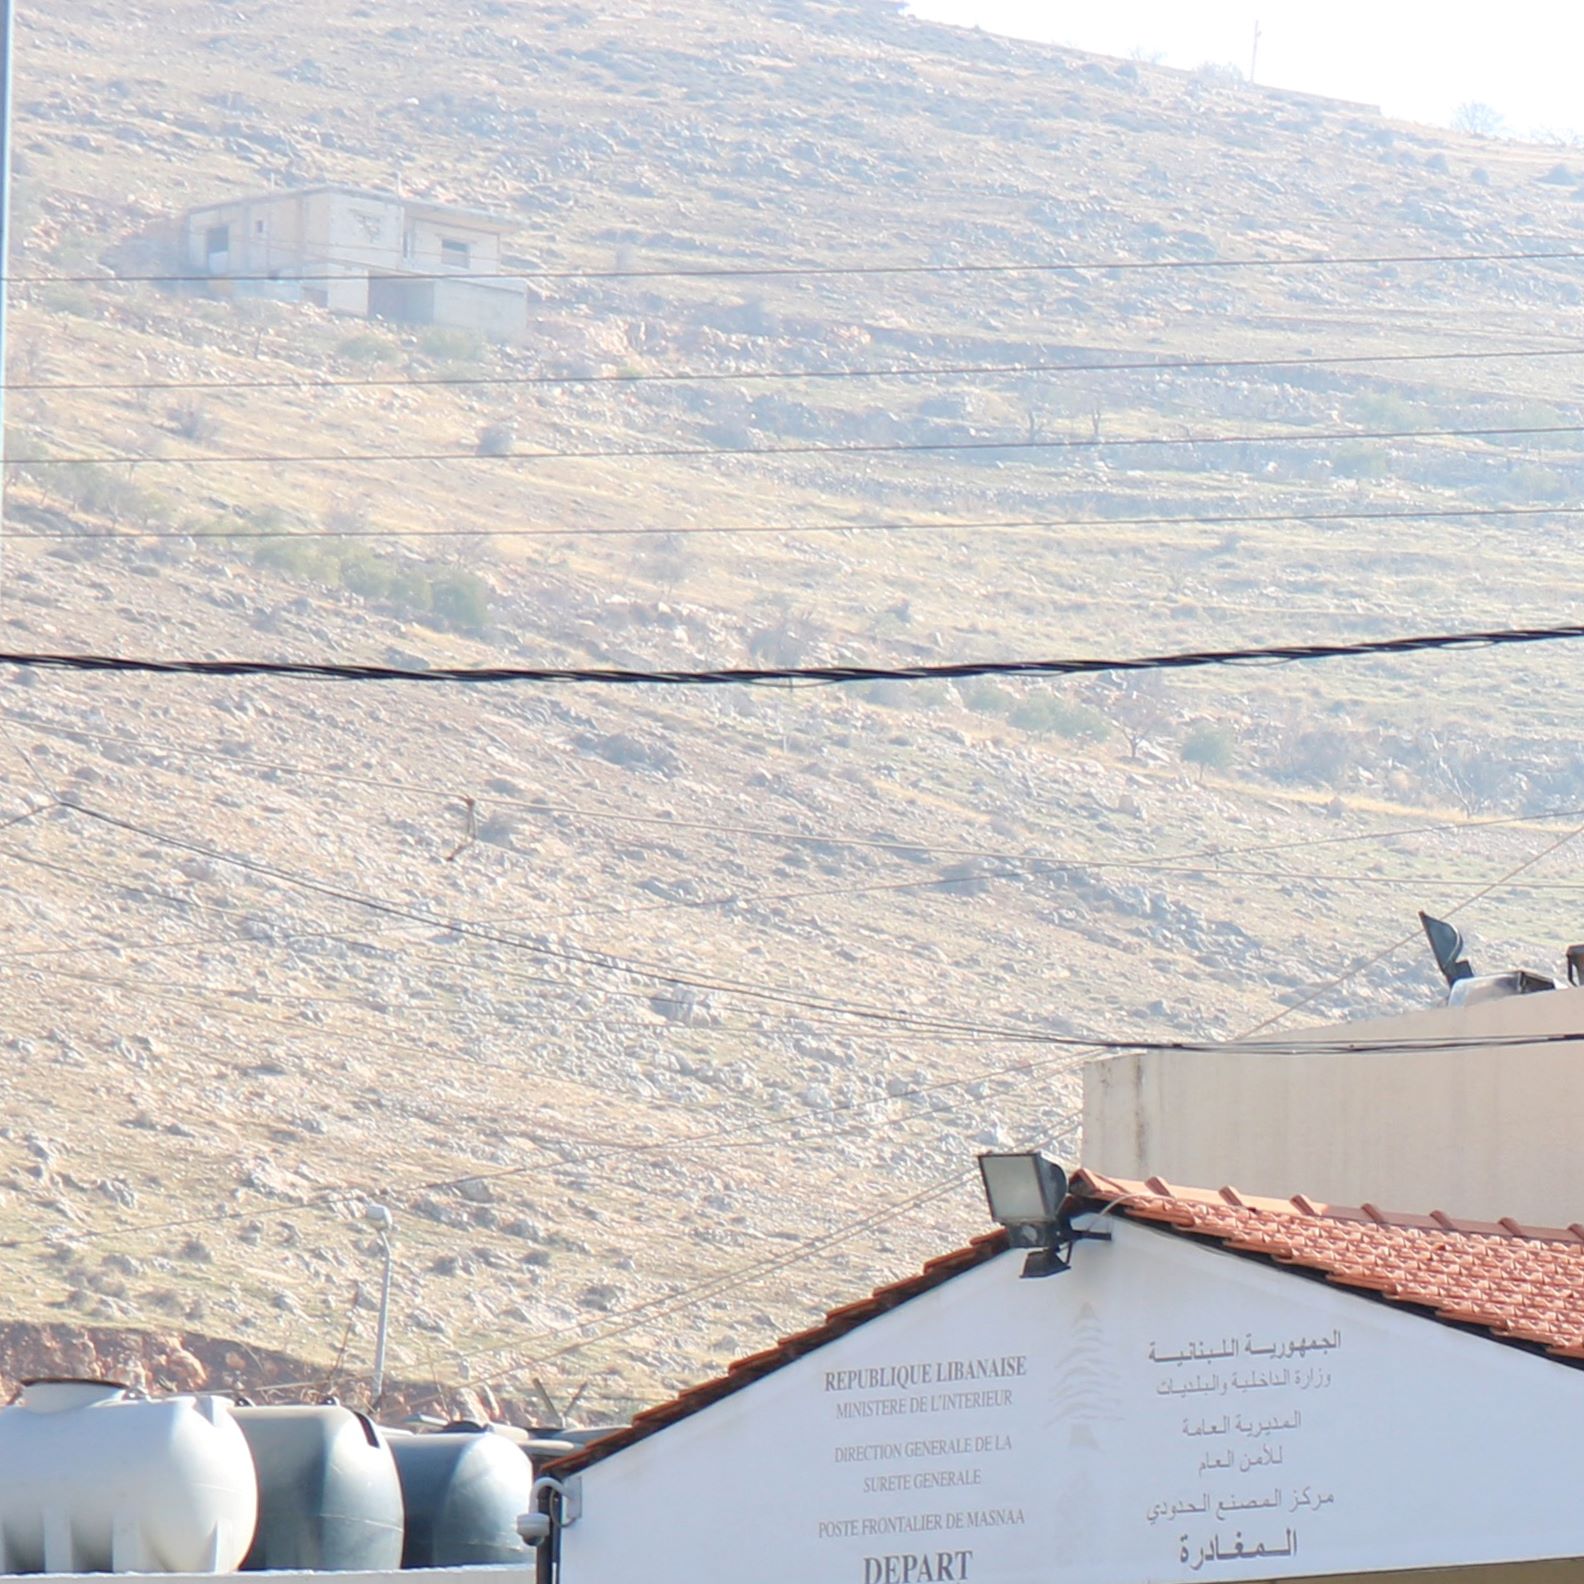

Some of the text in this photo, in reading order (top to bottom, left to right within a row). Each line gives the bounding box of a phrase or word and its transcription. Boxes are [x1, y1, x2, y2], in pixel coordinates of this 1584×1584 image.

[1148, 1329, 1341, 1367] الجمهورية اللبنانية
[824, 1355, 1028, 1393] REPUBLIQUE LIBANAISE
[1156, 1367, 1332, 1398] وزارة الداخلية والبلديات
[836, 1398, 907, 1419] MINISTERE
[910, 1395, 928, 1414] DE
[1182, 1410, 1301, 1438] المديرية العامة
[835, 1434, 1012, 1463] DIRECTION GENERALE DE LA
[1199, 1449, 1234, 1478] العام
[863, 1468, 982, 1493] SURETE GENERALE
[1147, 1486, 1335, 1526] مركز المصنع الحدودي
[818, 1508, 1026, 1539] POSTE FRONTALIER DE MASNAA
[1180, 1528, 1298, 1571] المغادرة
